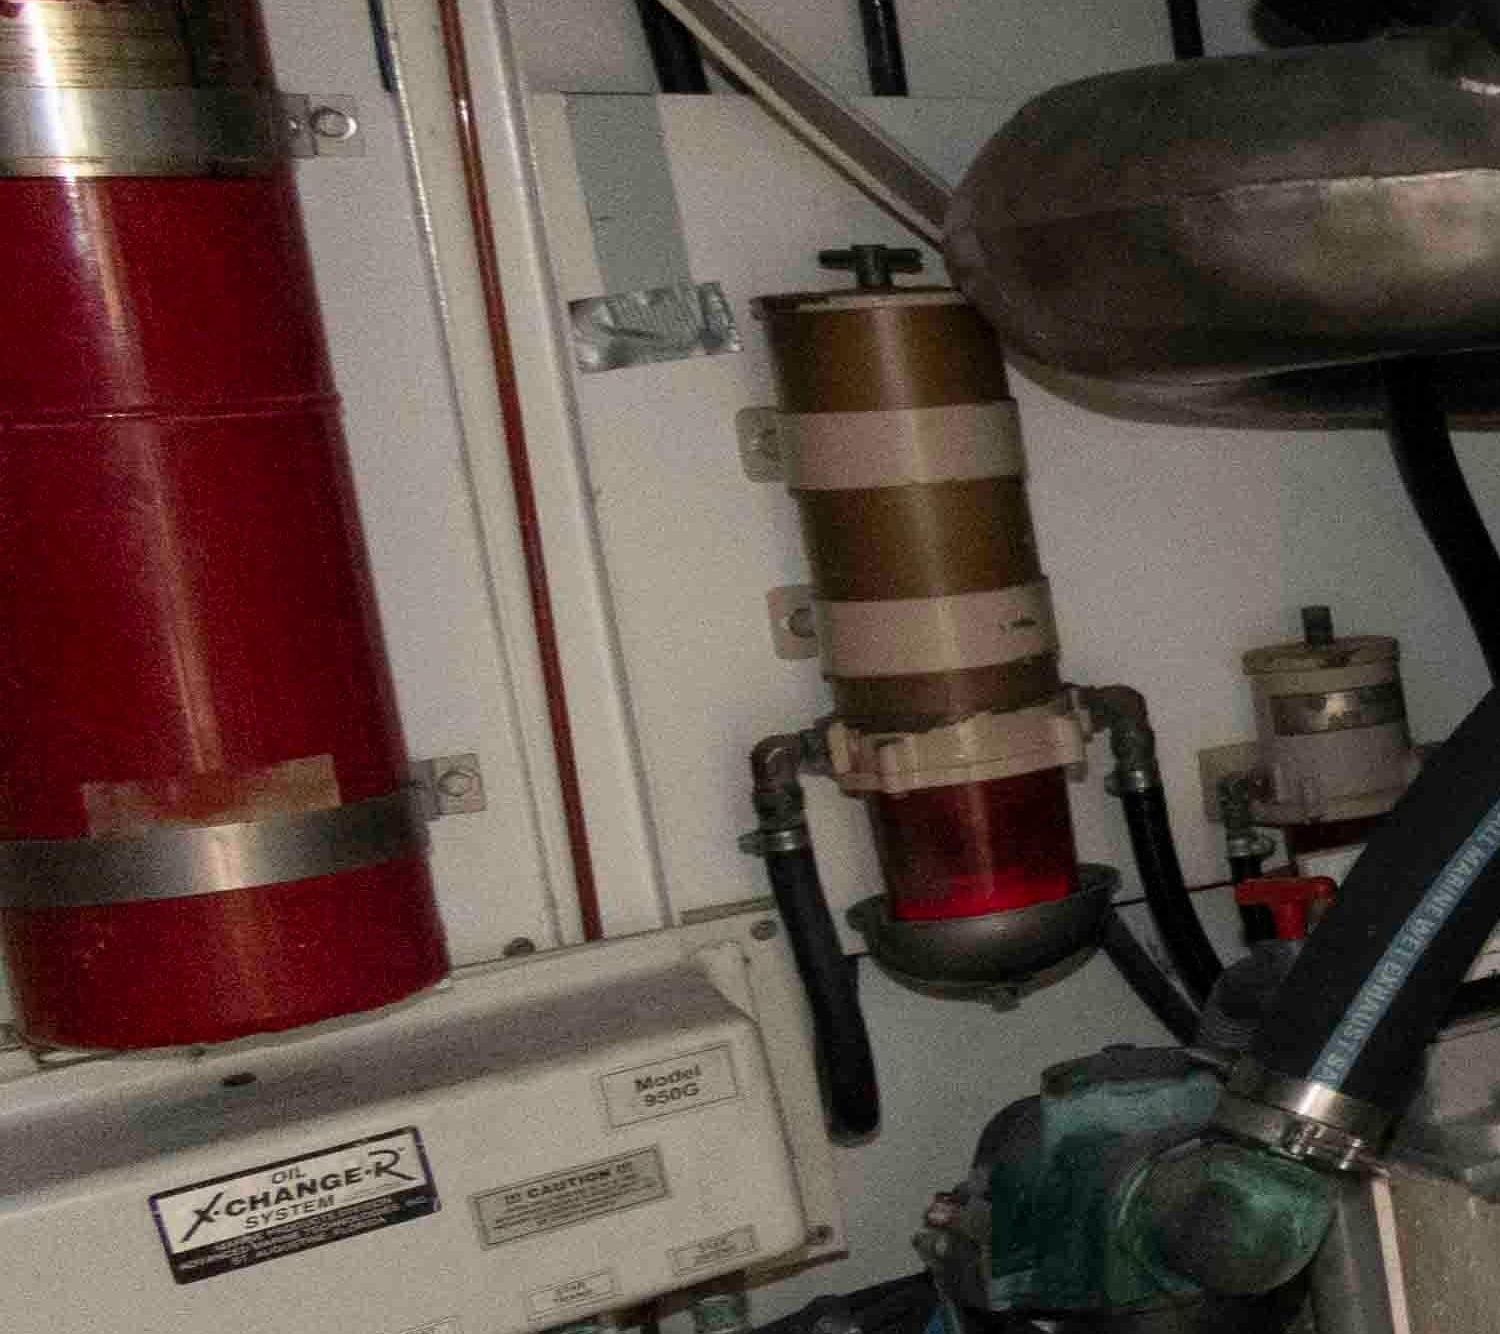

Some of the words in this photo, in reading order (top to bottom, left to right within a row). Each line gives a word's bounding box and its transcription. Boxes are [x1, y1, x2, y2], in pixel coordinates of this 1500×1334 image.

[634, 1065, 702, 1092] Model
[644, 1082, 700, 1107] 950G
[271, 1166, 305, 1185] OIL
[527, 1168, 611, 1200] CAUTION
[244, 1194, 335, 1230] SYSTEM
